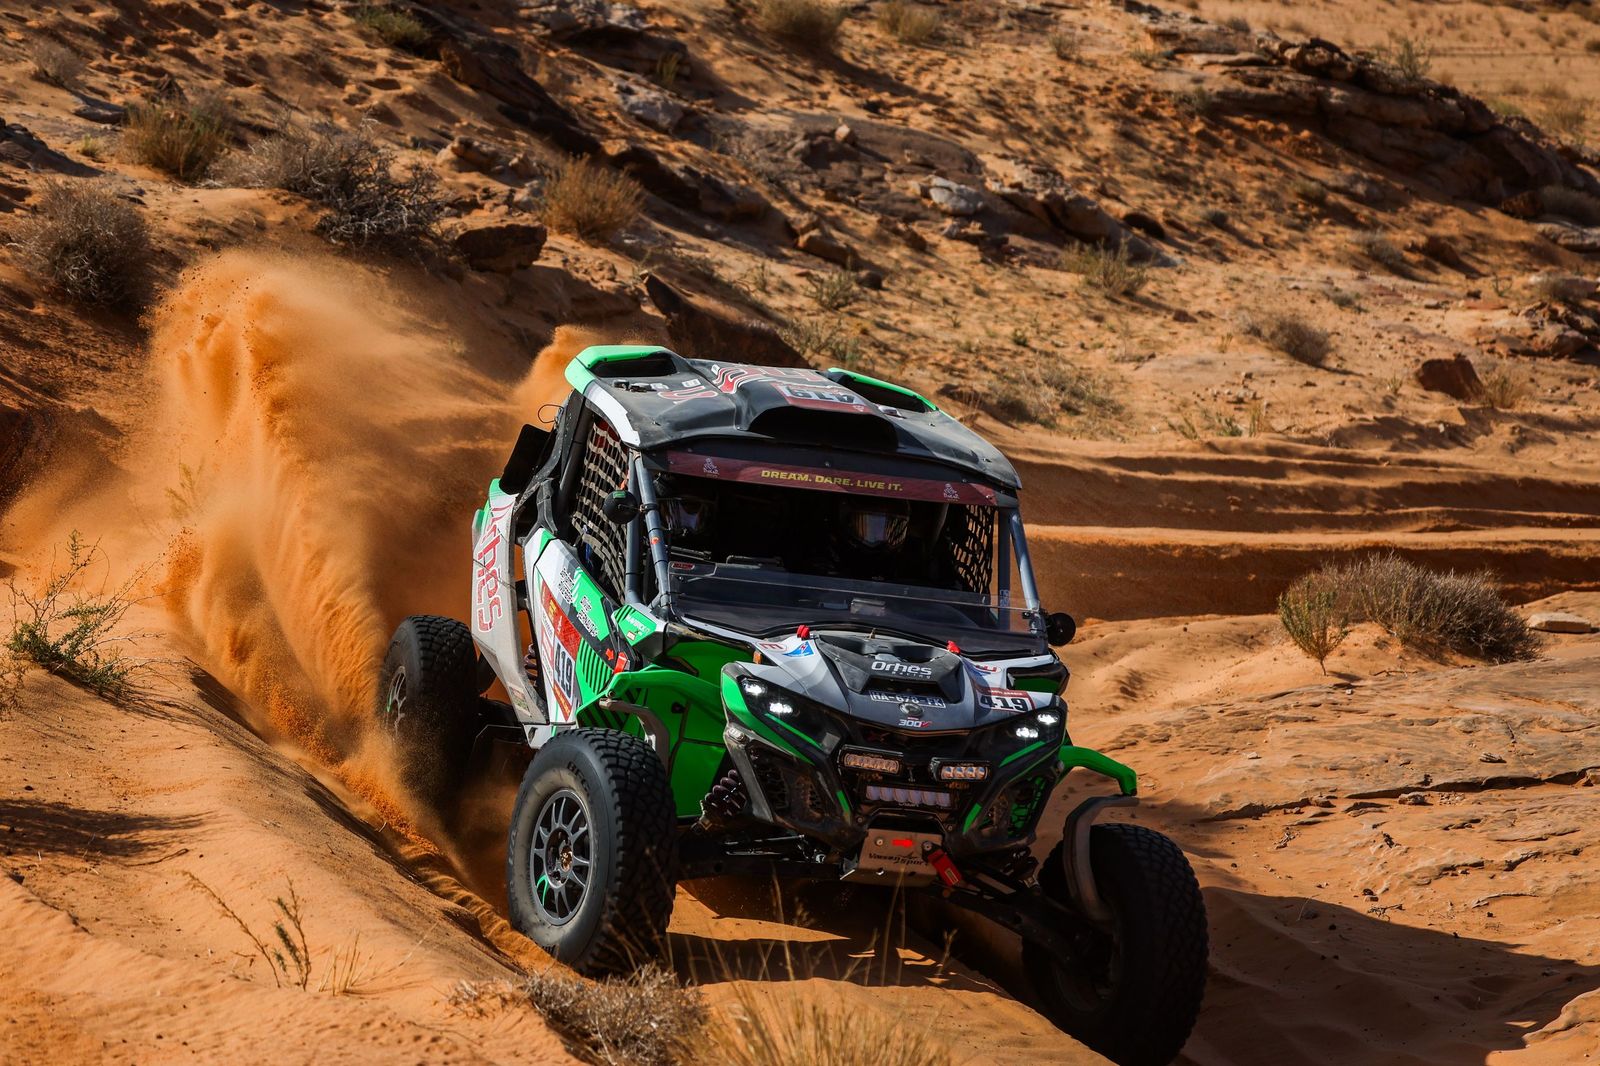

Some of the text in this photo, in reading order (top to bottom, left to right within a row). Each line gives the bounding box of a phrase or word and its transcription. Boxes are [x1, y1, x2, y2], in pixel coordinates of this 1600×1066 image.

[761, 470, 904, 491] DREAM. DARE. LIVE IT.
[554, 641, 575, 699] 419
[979, 694, 1029, 712] 419
